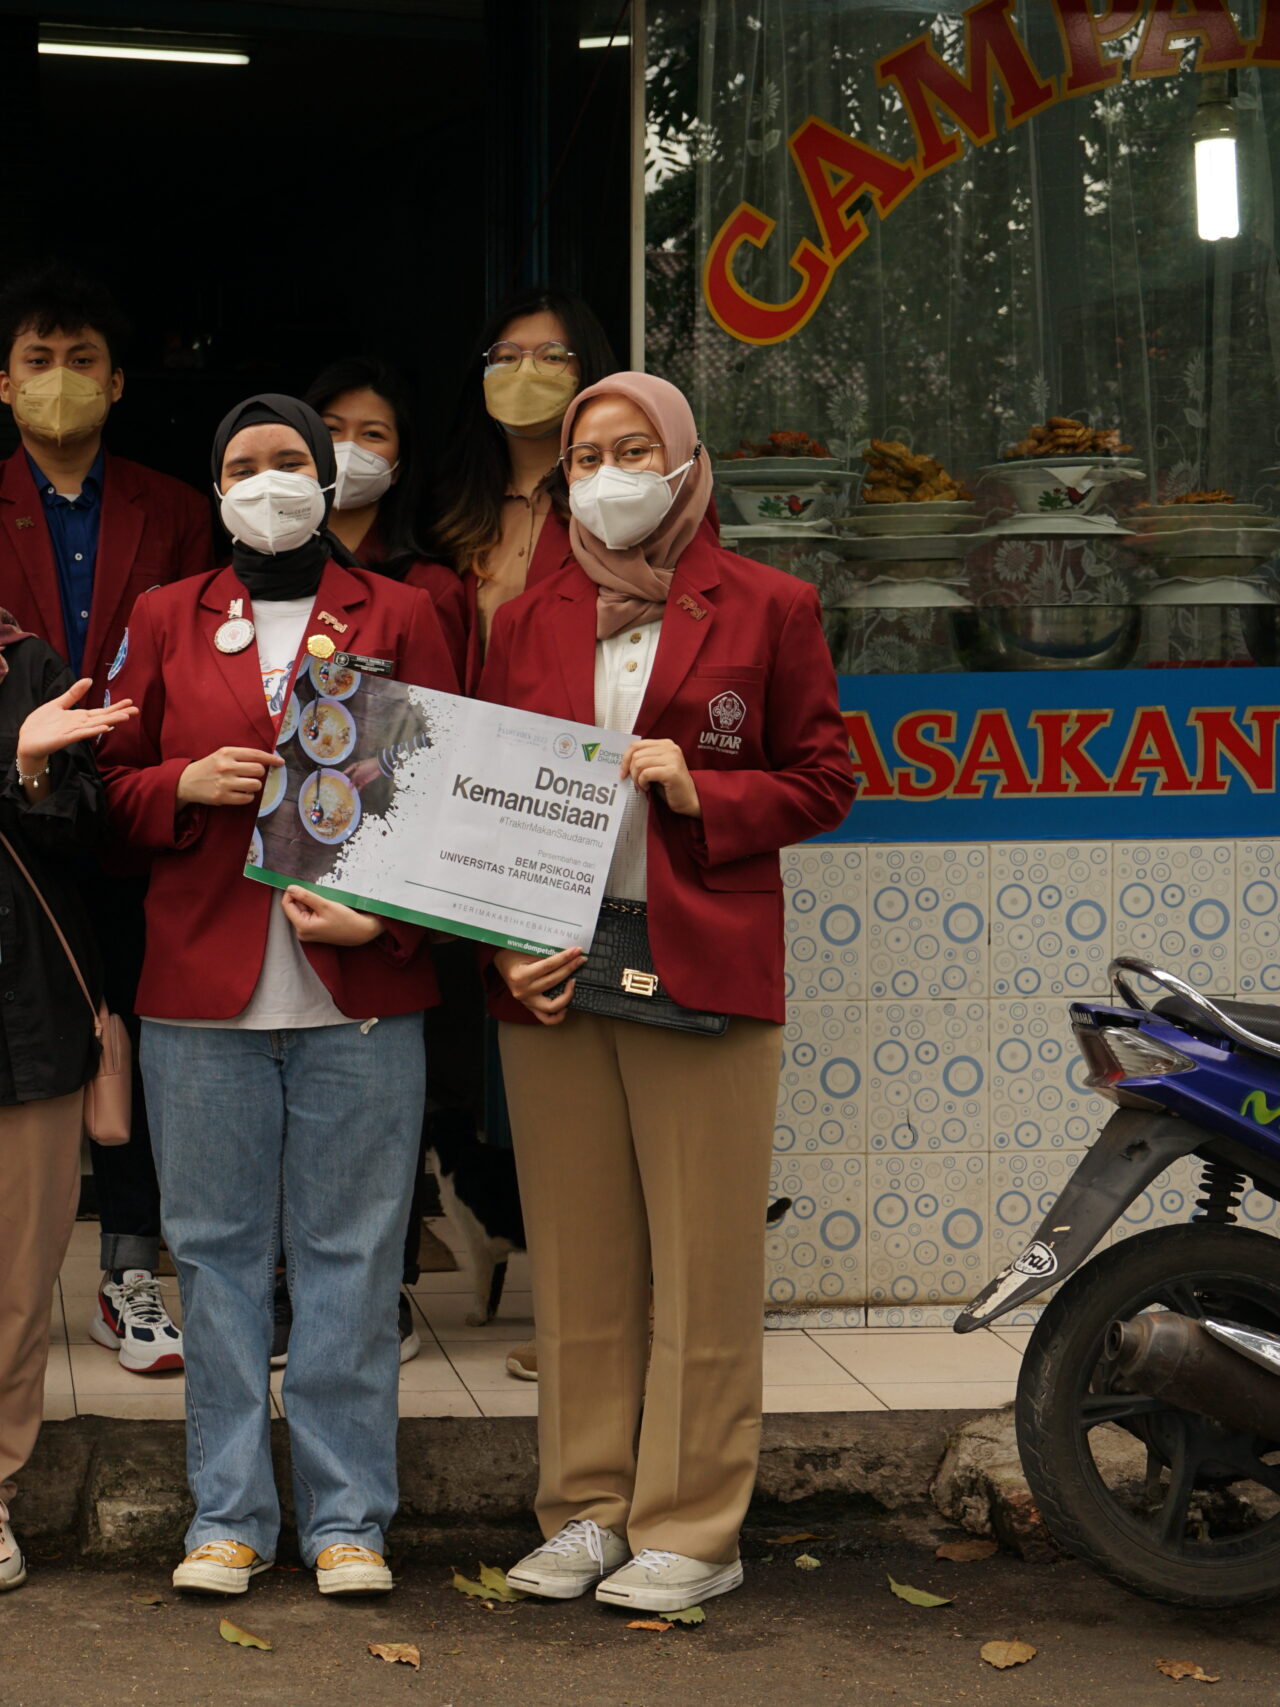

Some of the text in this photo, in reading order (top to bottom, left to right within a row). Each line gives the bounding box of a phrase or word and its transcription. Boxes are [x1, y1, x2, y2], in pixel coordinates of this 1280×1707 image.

[699, 731, 742, 750] UNTAR
[451, 774, 609, 832] Kemanusiaan
[535, 766, 618, 806] Donasi
[499, 815, 604, 849] #TraktirMakanSaudaramu
[439, 850, 591, 896] UNIVERSITAS TARUMANEGARA
[515, 856, 595, 884] BEM PSIKOLOGI
